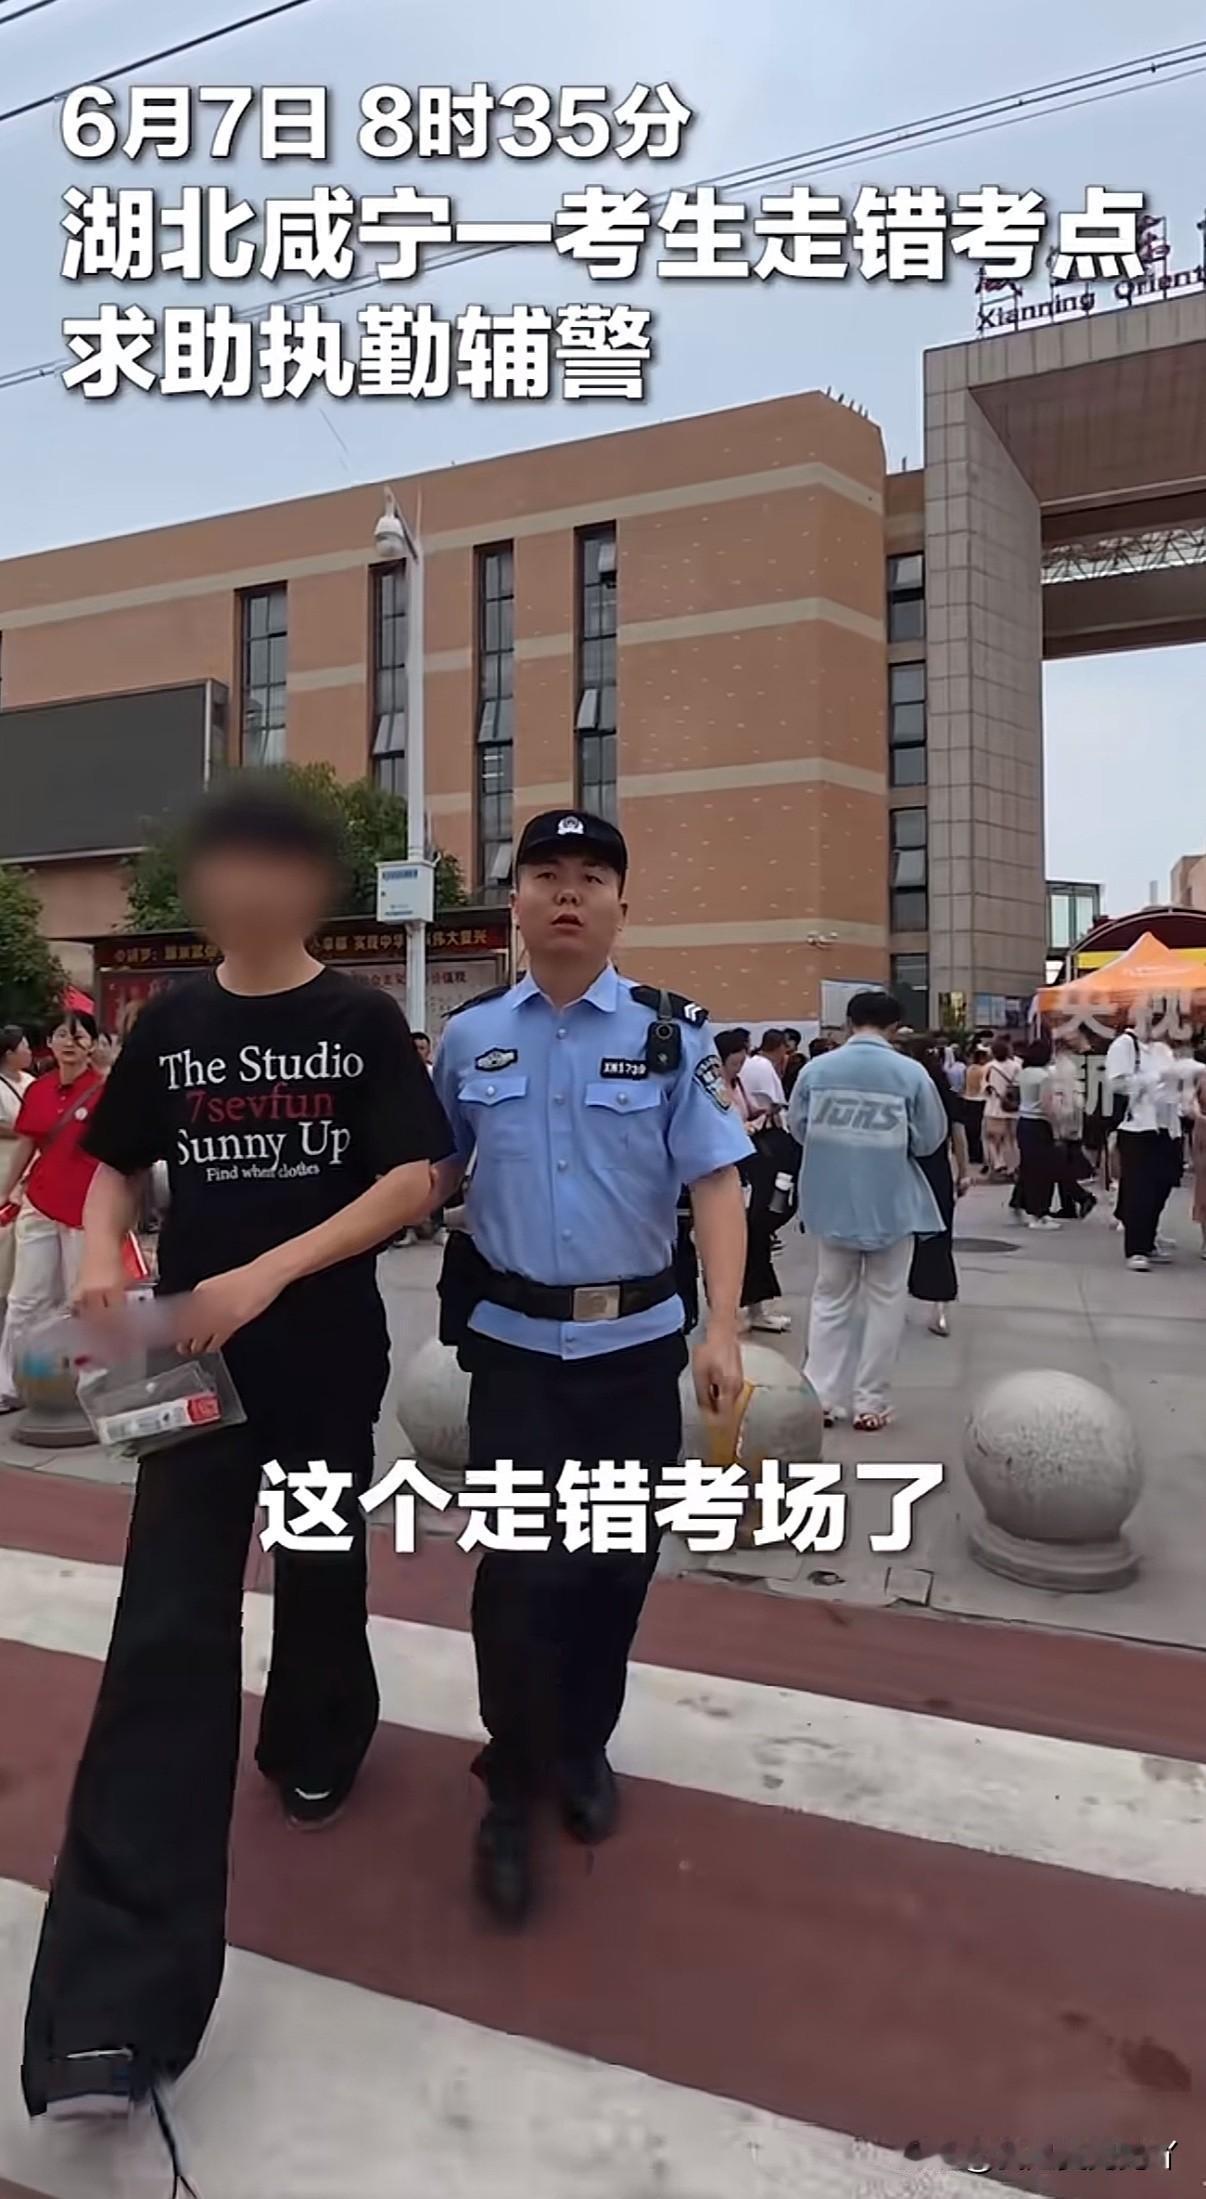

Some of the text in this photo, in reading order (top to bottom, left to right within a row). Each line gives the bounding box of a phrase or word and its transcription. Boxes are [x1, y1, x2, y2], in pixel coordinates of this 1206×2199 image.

[975, 289, 1096, 332] Xianning
[159, 1041, 365, 1090] The Studio
[186, 1082, 334, 1124] 7sevfun
[298, 1119, 350, 1165] Up
[206, 1164, 239, 1182] Find
